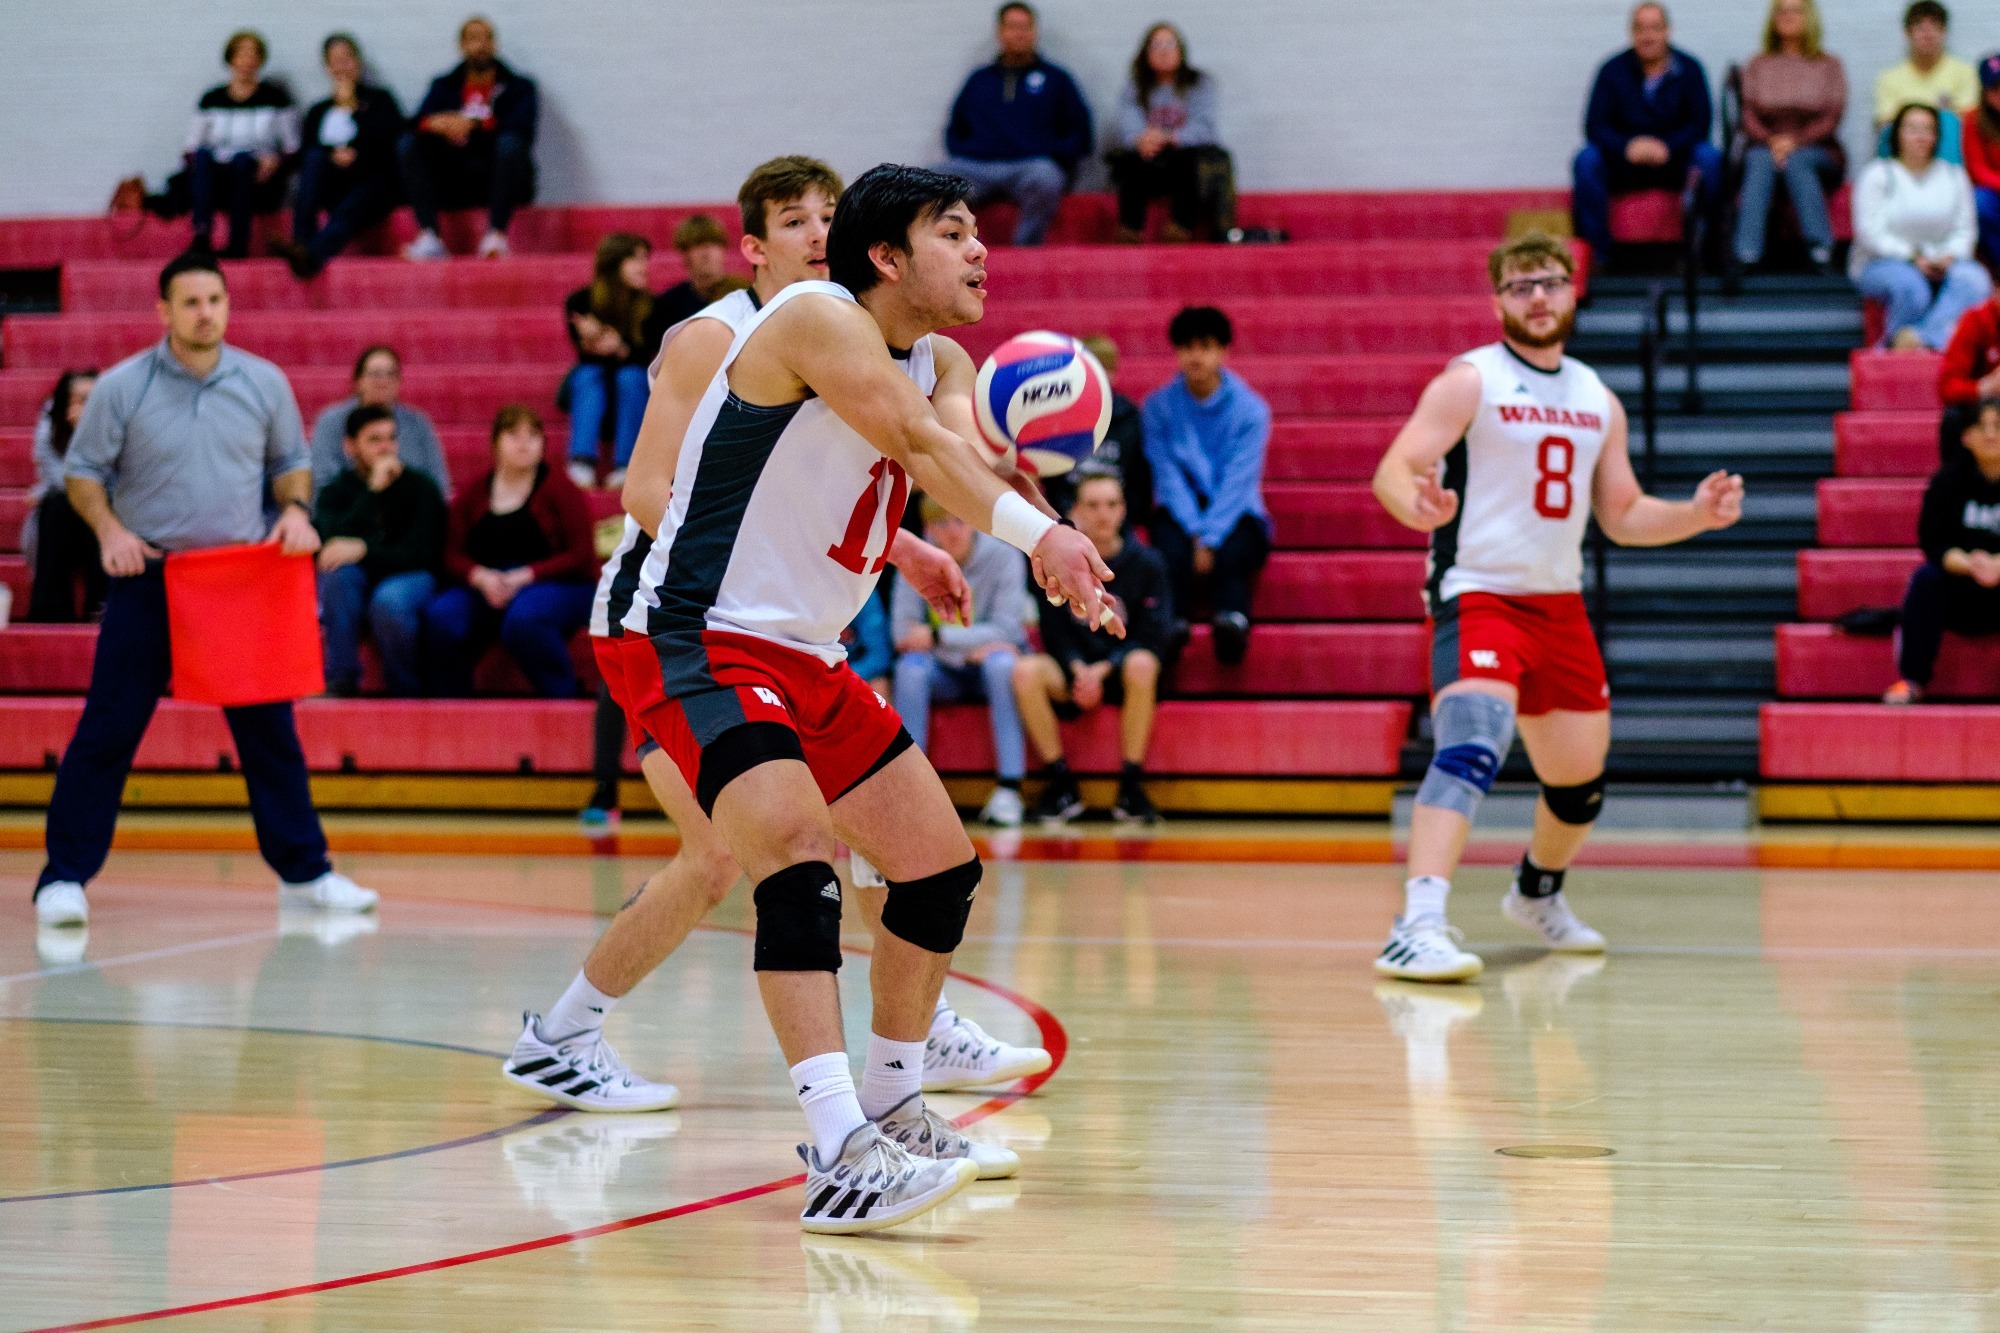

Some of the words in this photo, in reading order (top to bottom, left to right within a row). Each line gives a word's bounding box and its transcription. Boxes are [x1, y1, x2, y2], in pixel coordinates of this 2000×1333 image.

[1022, 382, 1071, 405] NCAA
[1498, 406, 1601, 431] WABASH
[1534, 435, 1575, 521] 8
[827, 456, 907, 575] 11
